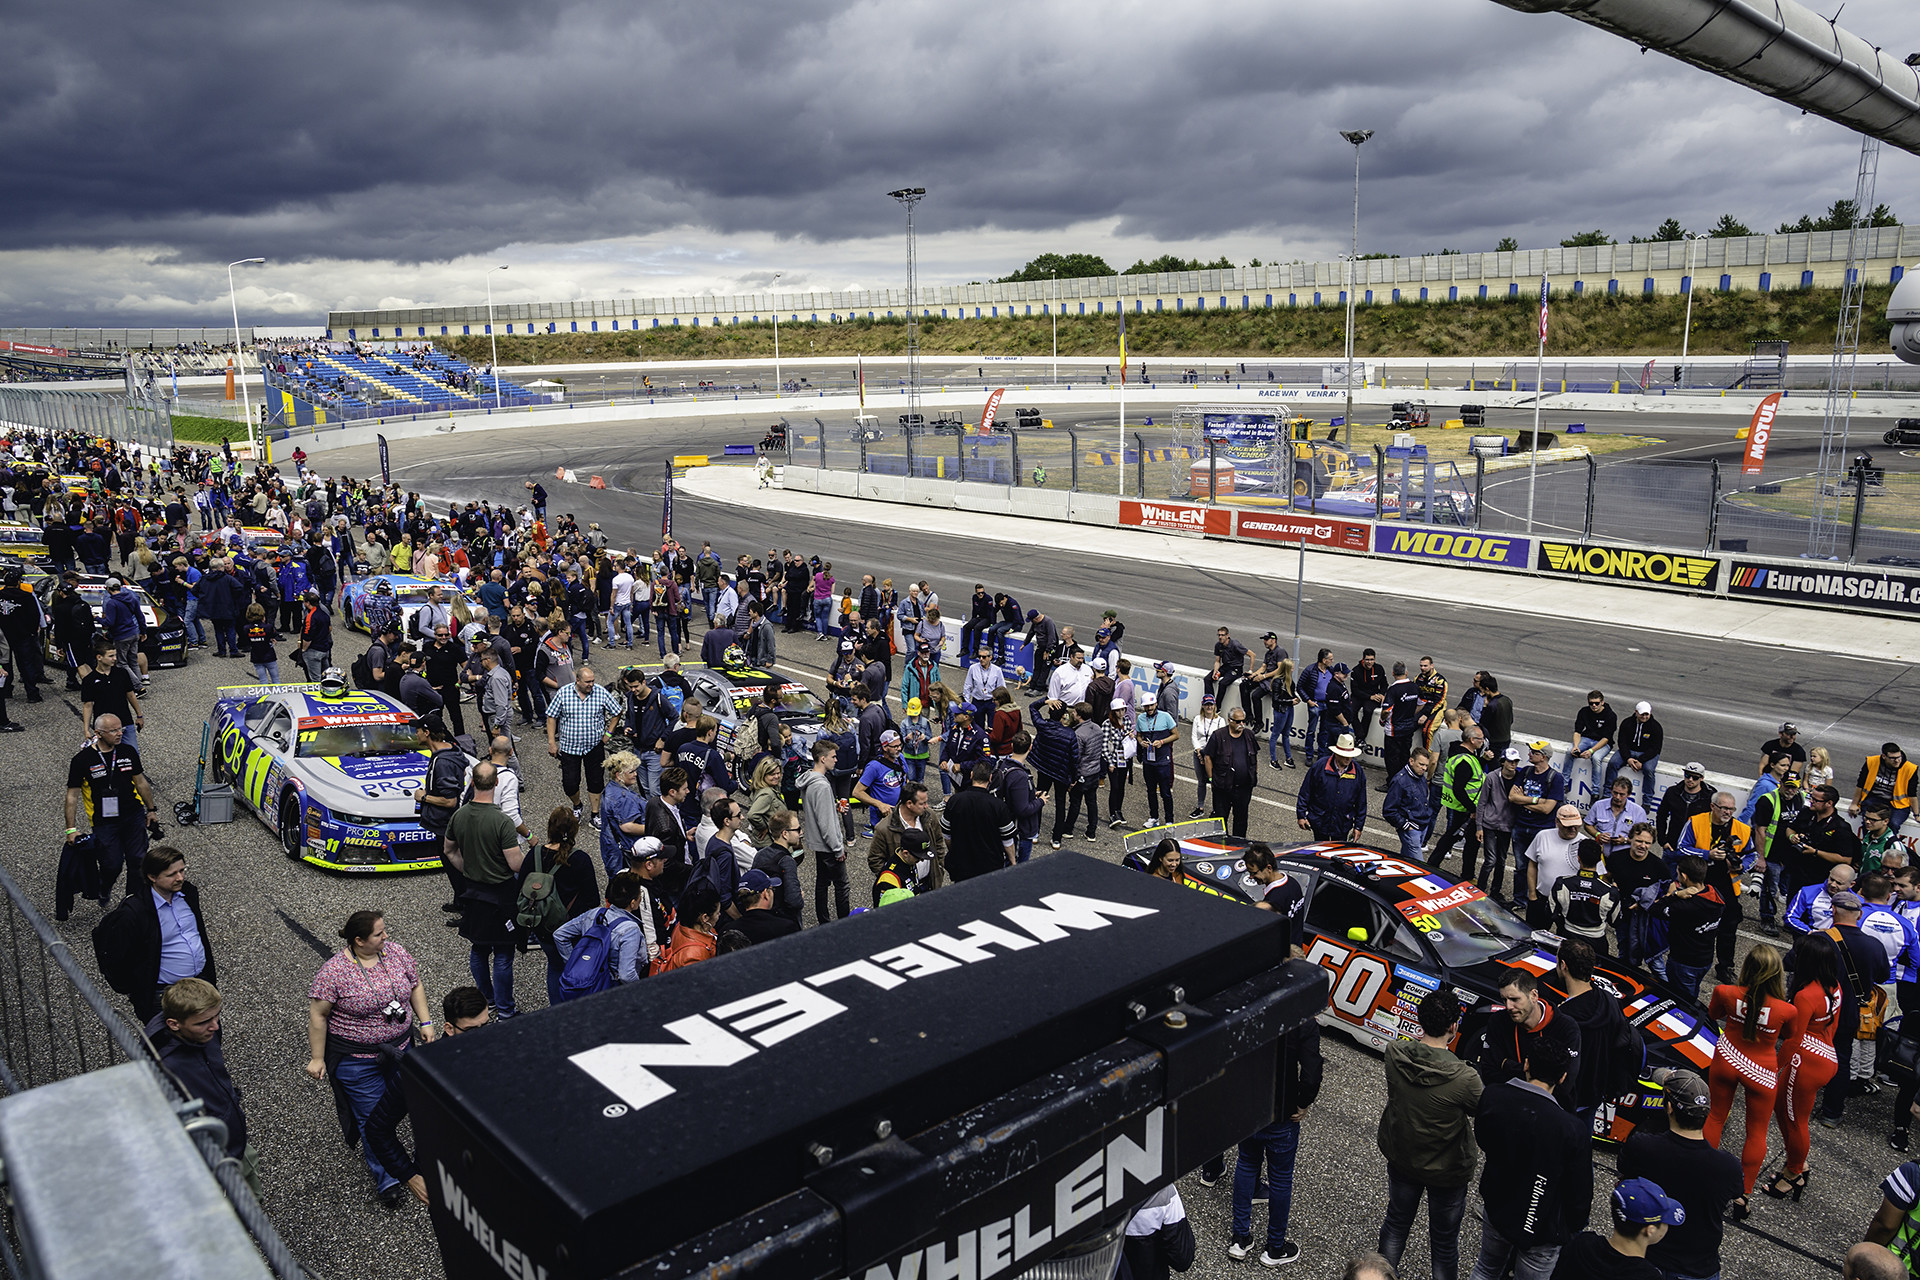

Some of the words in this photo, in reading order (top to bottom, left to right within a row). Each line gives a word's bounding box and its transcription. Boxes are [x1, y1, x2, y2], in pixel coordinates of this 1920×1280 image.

[983, 395, 1001, 429] MOTUL
[1750, 402, 1777, 460] MOTUL
[1140, 503, 1206, 525] WHELEN
[1242, 521, 1289, 533] GENERAL
[1289, 525, 1314, 535] TIRE
[1391, 530, 1511, 562] MOOG
[1560, 545, 1690, 585] MONROE
[317, 704, 389, 714] PROJOB
[734, 698, 752, 709] 24
[322, 713, 397, 724] WHELEN
[299, 731, 318, 742] 11
[244, 747, 273, 809] 11
[360, 779, 422, 796] PRO
[346, 827, 380, 838] PROJOB
[326, 838, 340, 853] 11
[343, 837, 384, 847] MOOG
[1416, 886, 1474, 912] WHELEN
[1410, 914, 1442, 933] 50
[1305, 939, 1388, 1017] 50
[1397, 990, 1422, 1005] MOO
[1405, 984, 1428, 996] COMET
[567, 893, 1160, 1111] WHELEN
[1365, 1020, 1394, 1037] tilton
[1786, 1085, 1795, 1121] GENERAL
[437, 1159, 549, 1280] WHELEN
